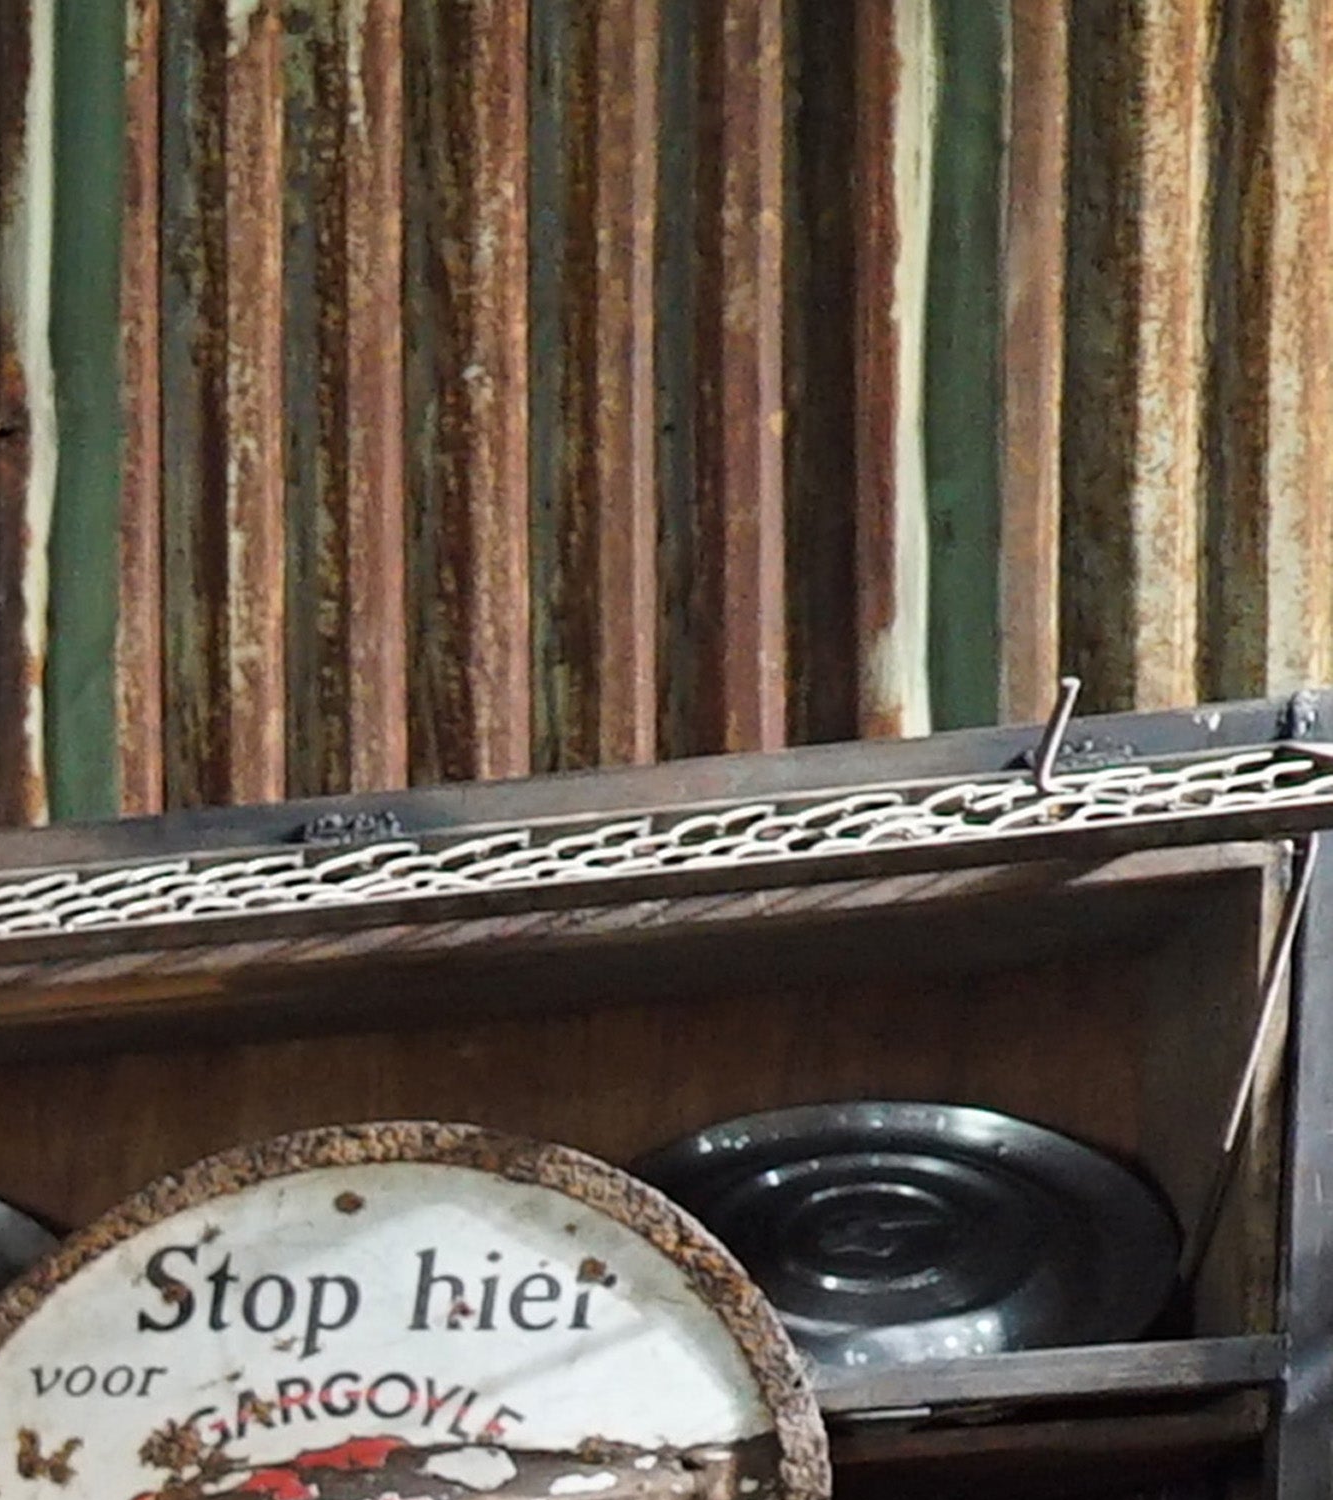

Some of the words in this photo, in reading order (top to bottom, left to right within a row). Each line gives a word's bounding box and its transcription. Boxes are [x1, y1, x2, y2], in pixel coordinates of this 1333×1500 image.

[138, 1245, 362, 1358] Stop
[408, 1247, 618, 1332] hier
[31, 1363, 167, 1398] voor
[189, 1371, 526, 1451] GARGOYLE
